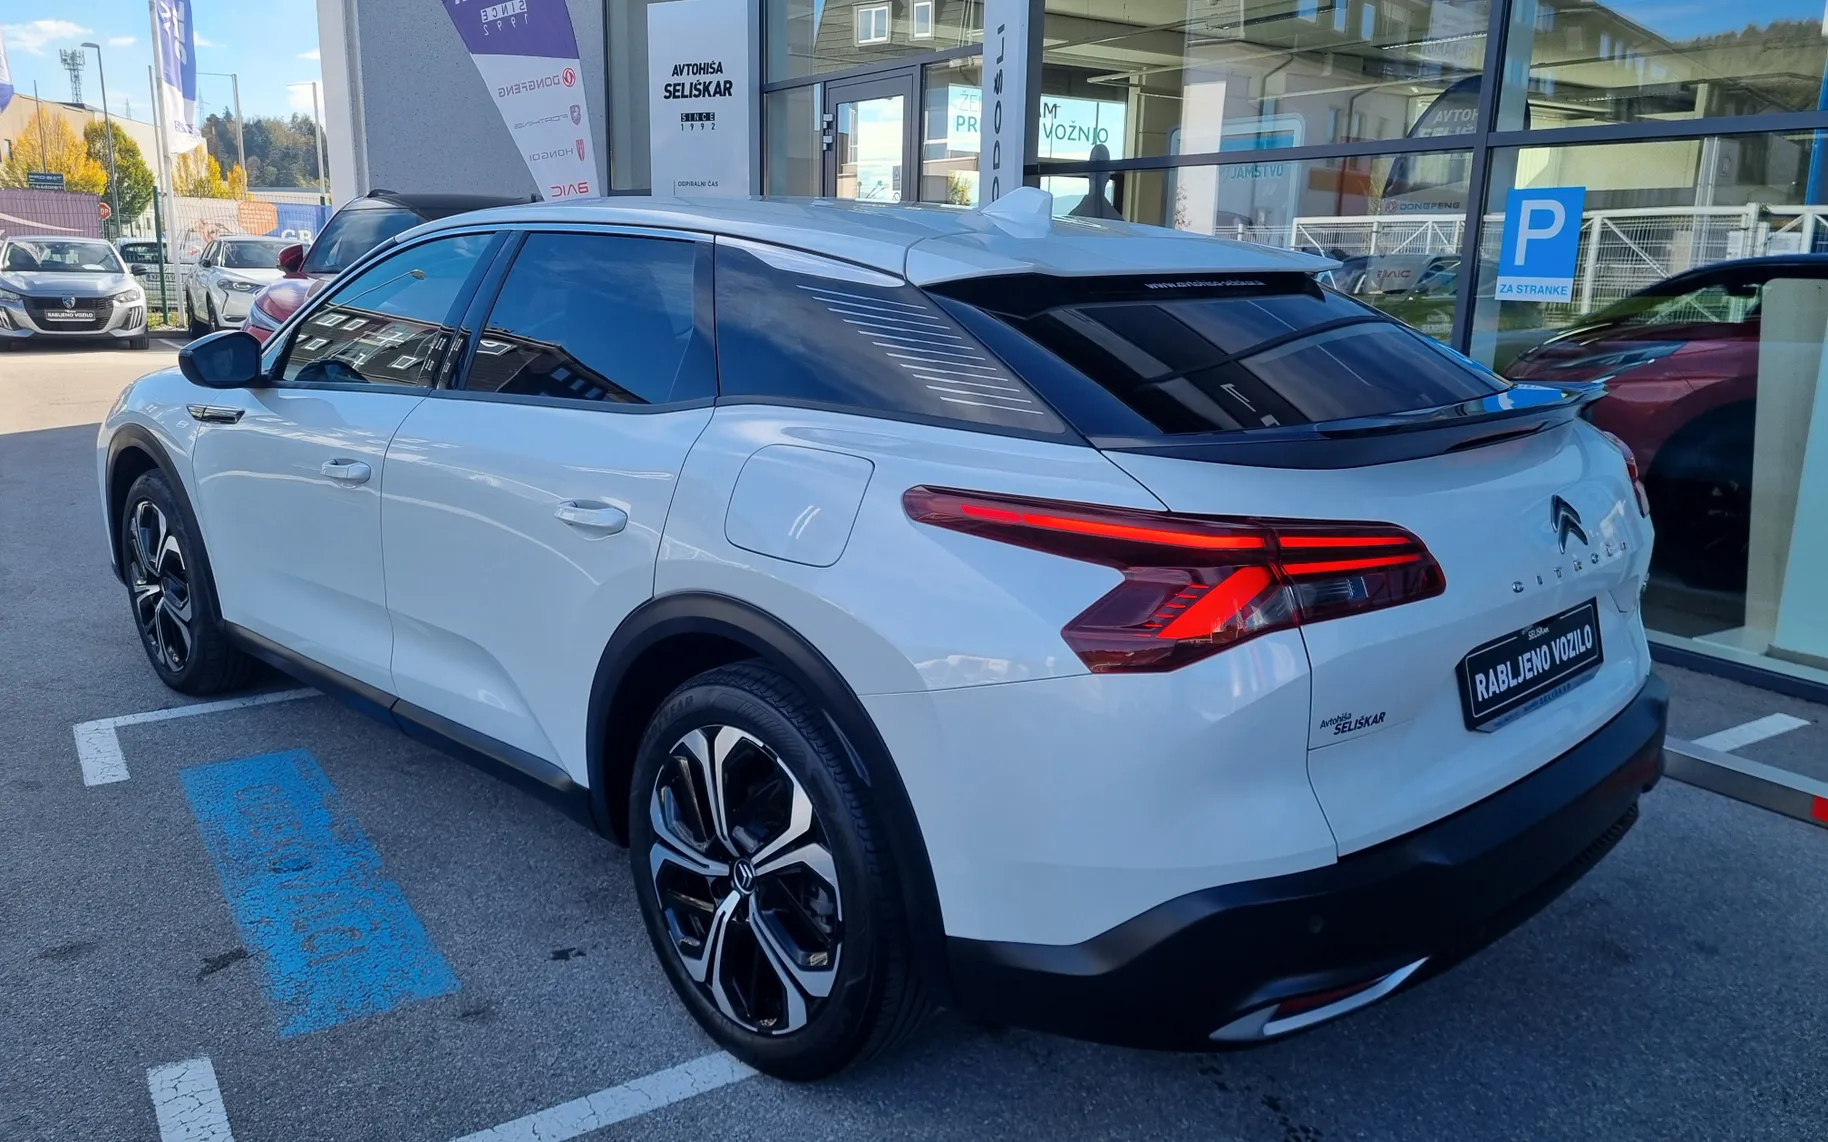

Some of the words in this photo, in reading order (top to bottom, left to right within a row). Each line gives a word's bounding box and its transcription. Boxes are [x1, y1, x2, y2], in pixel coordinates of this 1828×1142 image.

[672, 60, 723, 77] AVTOHIŠA
[663, 79, 733, 100] SELIŠKAR
[682, 112, 714, 122] SINCE
[681, 123, 715, 131] 1992
[1043, 120, 1109, 146] VOŽNJO
[1230, 164, 1284, 179] JAMSTVO
[707, 179, 719, 187] ČAS
[1400, 201, 1460, 211] DONGFENG
[1514, 199, 1566, 266] P
[1500, 284, 1514, 294] ZA
[1516, 284, 1568, 296] STRANKE
[1475, 644, 1551, 702] RABLJENO
[1551, 624, 1593, 665] VOZILO
[1319, 712, 1352, 730] Avtohiša
[1333, 711, 1386, 736] SELIŠKAR
